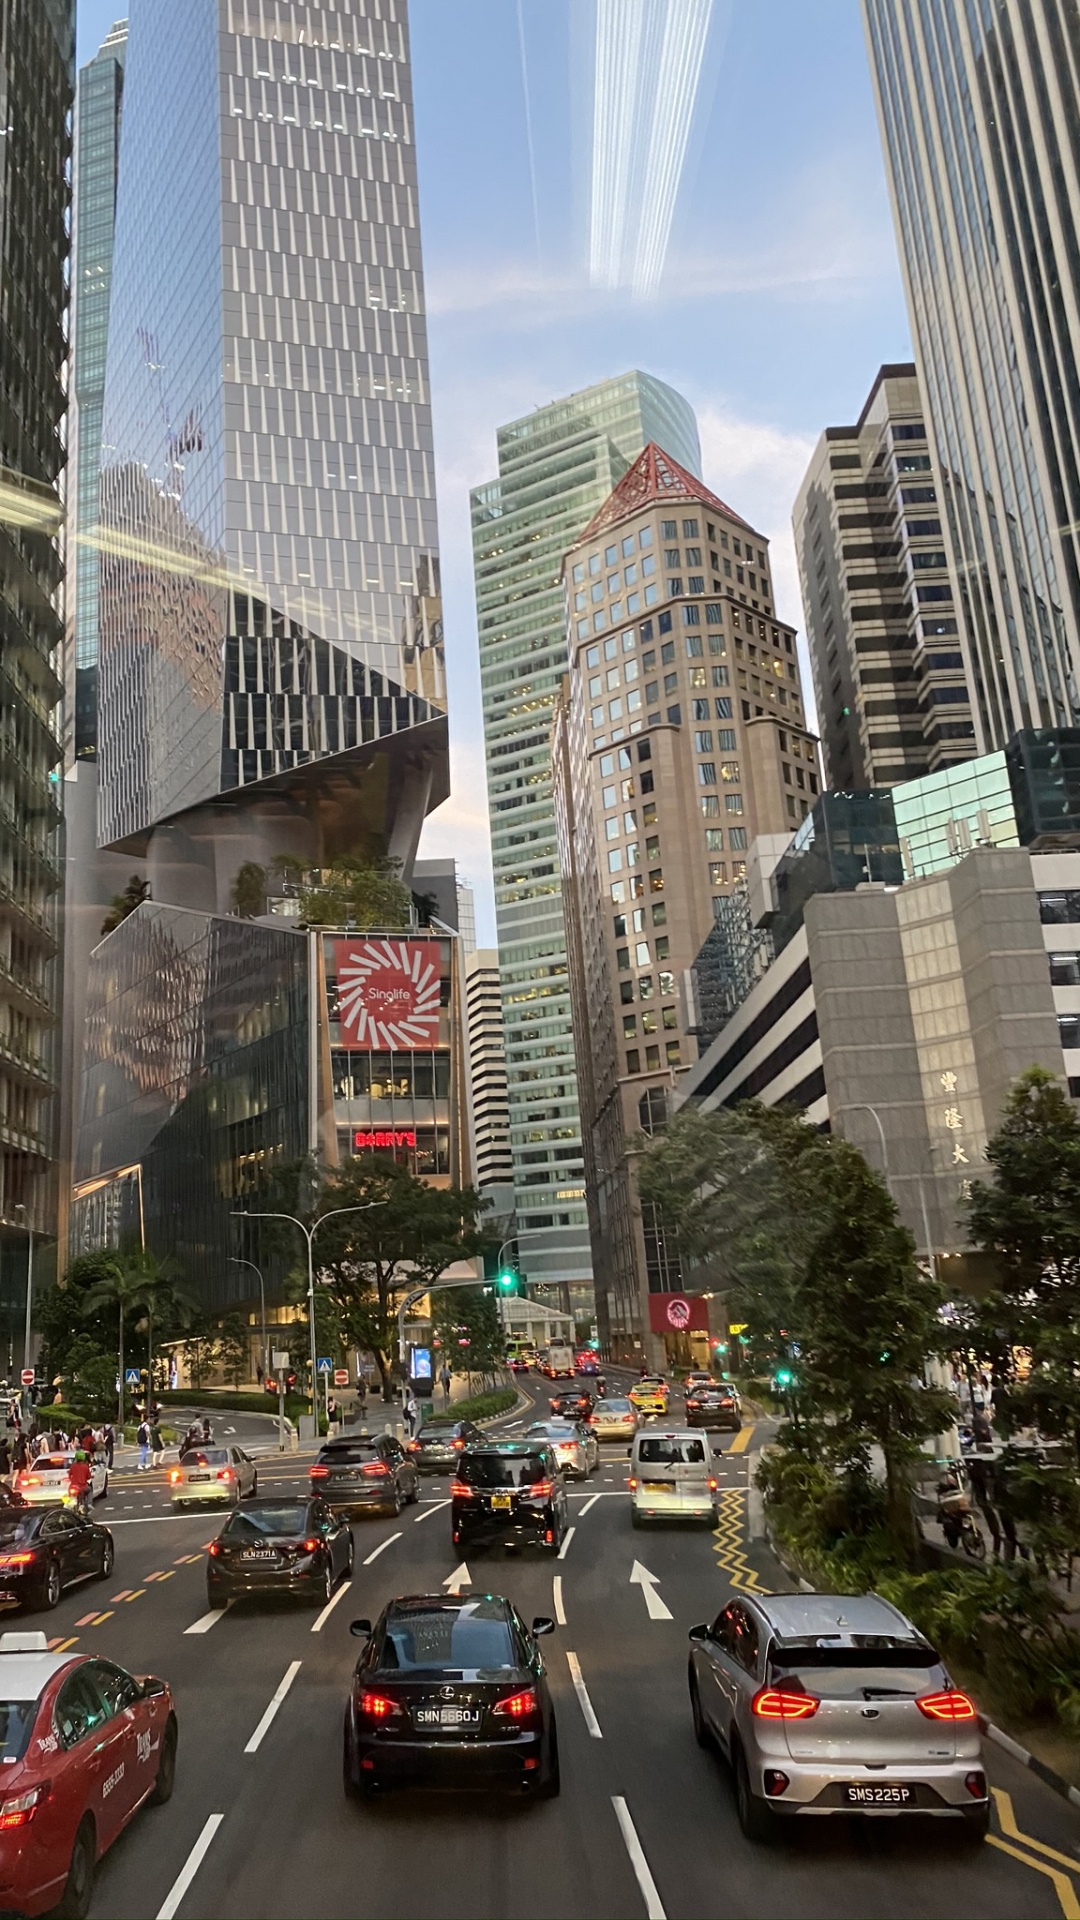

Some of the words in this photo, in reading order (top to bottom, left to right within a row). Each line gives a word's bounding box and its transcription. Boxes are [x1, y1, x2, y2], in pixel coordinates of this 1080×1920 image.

[369, 988, 410, 1002] Singlife
[355, 1132, 416, 1147] BARRY'S
[242, 1550, 276, 1558] SLN2371A
[848, 1788, 910, 1801] SMS225P
